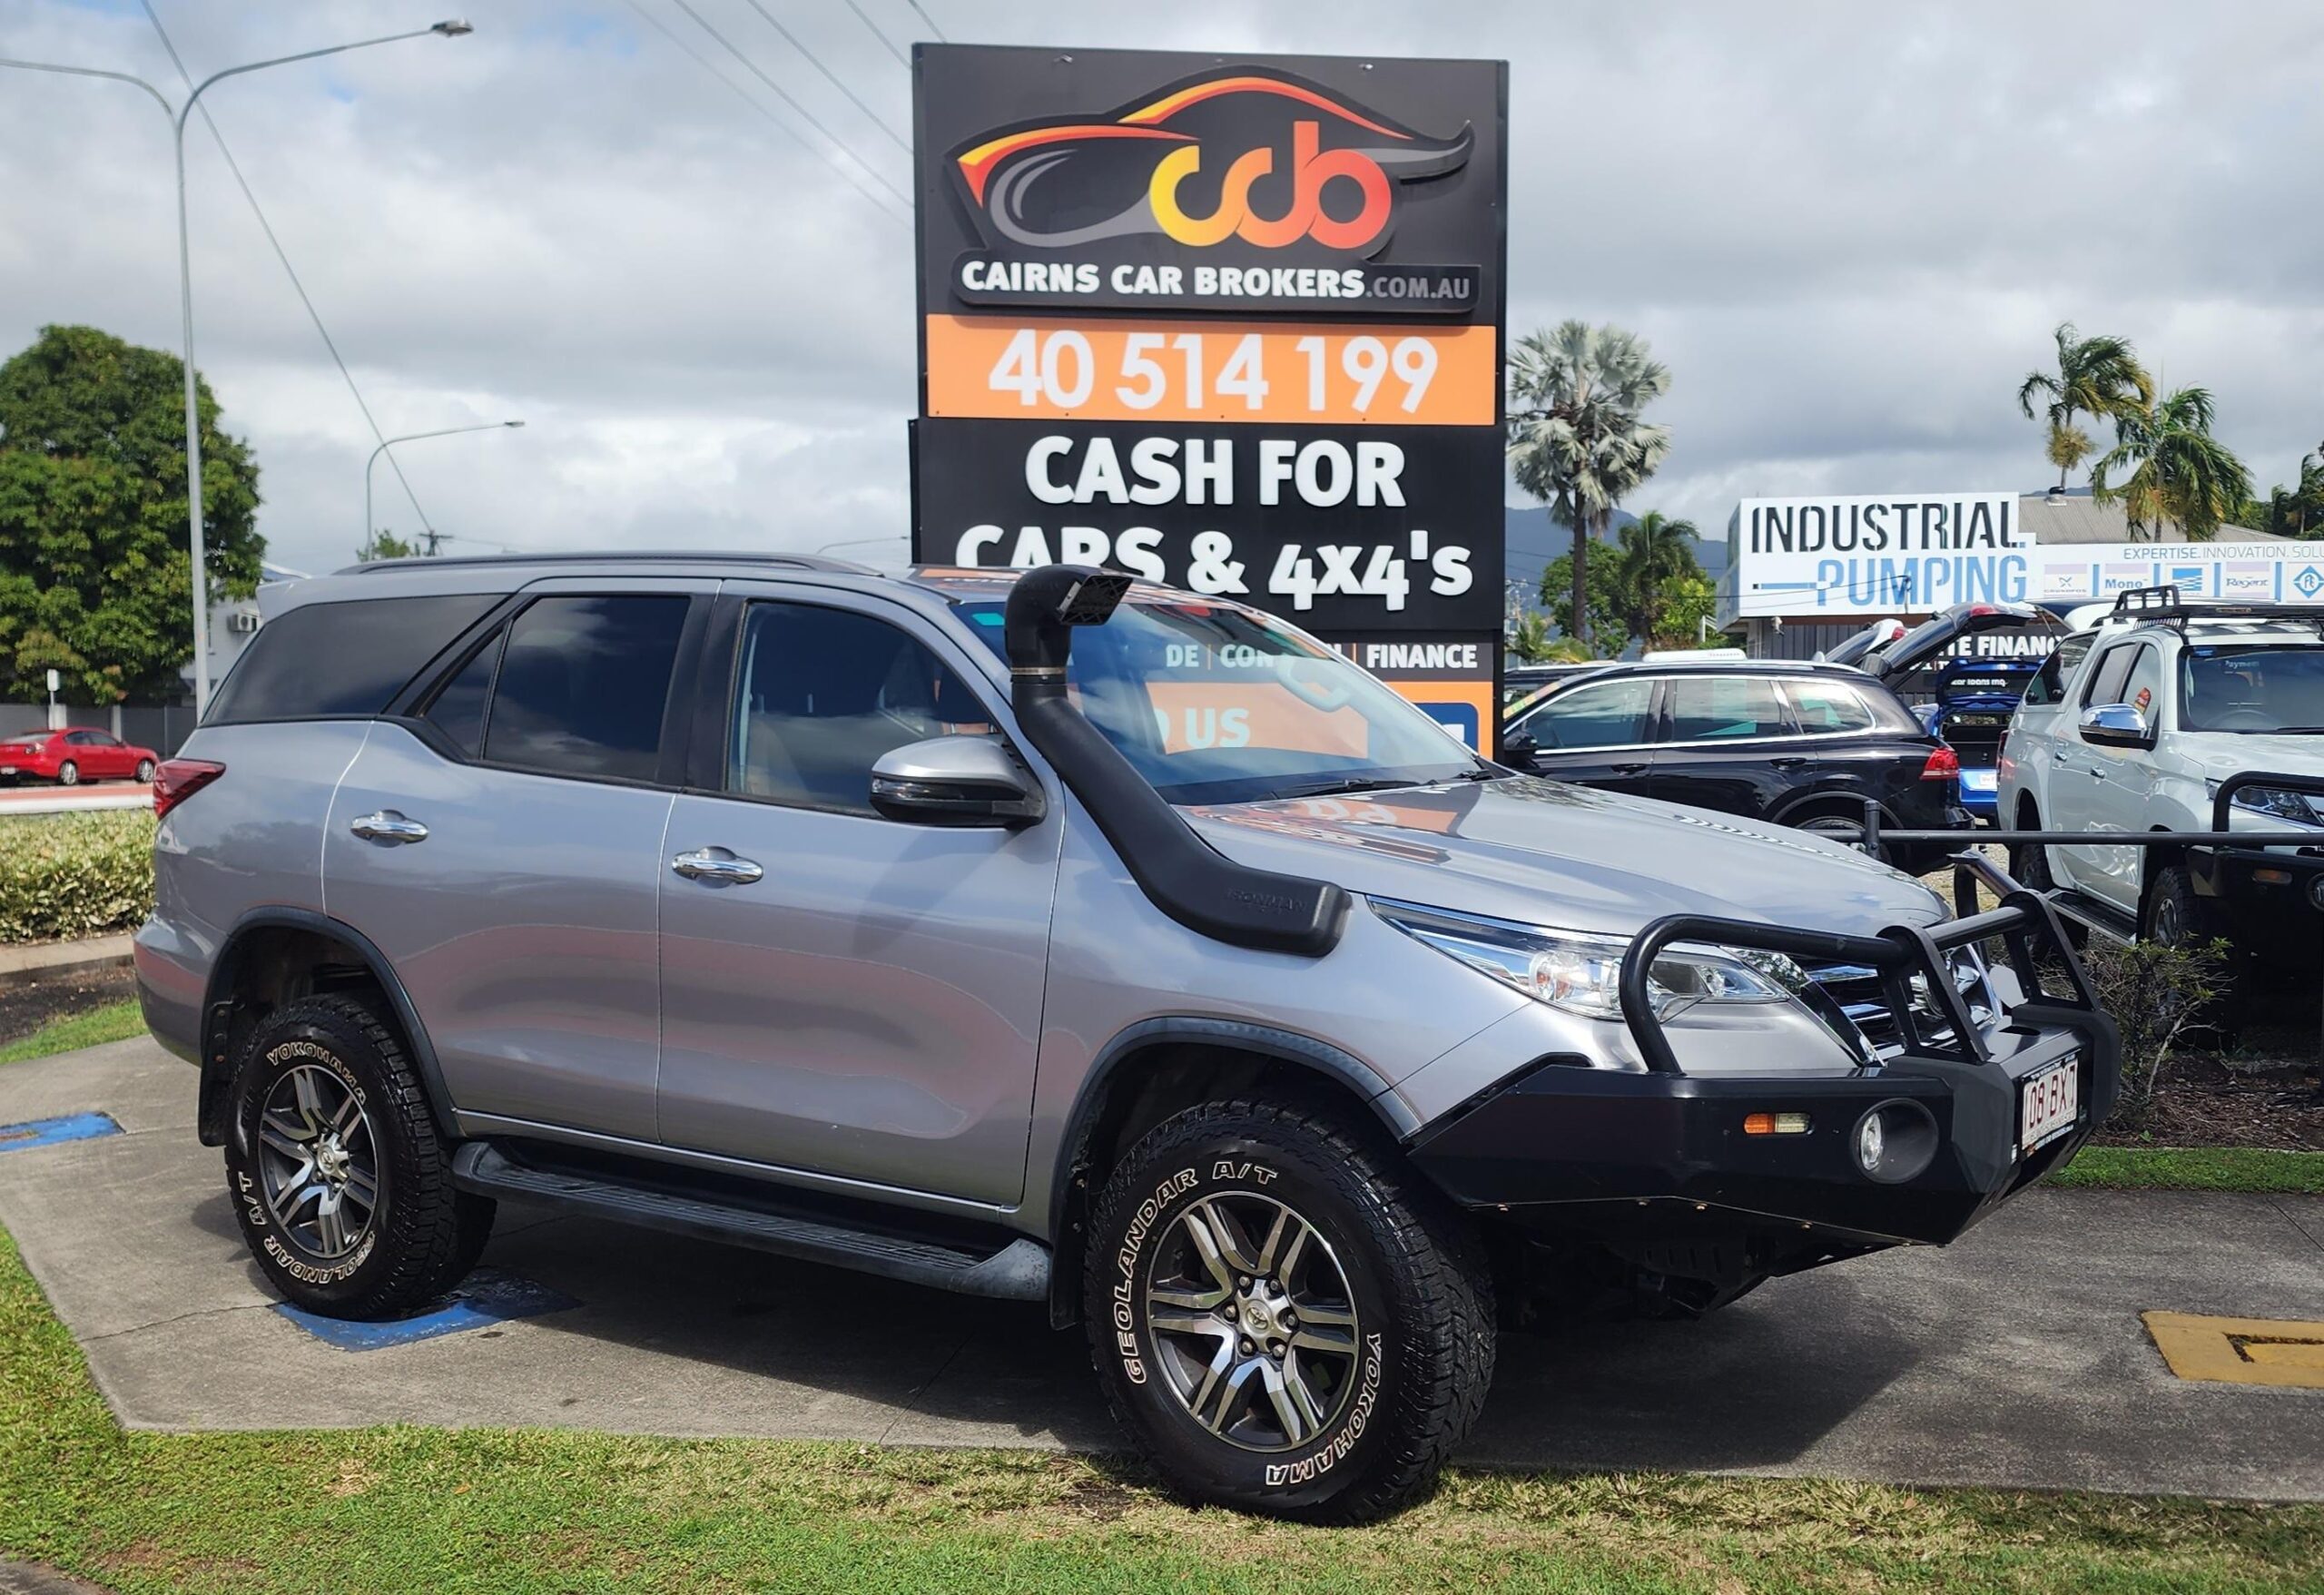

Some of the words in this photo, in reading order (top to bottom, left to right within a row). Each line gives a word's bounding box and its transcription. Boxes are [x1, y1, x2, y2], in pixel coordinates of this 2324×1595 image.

[962, 261, 1099, 294] CAIRNS
[1110, 264, 1184, 296] CAR
[990, 329, 1095, 408] 40
[1116, 332, 1269, 410] 514
[1295, 336, 1438, 413] 199
[1025, 436, 1235, 506] CASH
[1259, 439, 1406, 507] FOR
[1751, 501, 2018, 553] INDUSTRIAL
[2123, 546, 2201, 560] EXPERTISE.
[2203, 545, 2290, 559] INNOVATION.
[955, 525, 1167, 585] CARS
[1187, 531, 1249, 595] &
[1817, 555, 2027, 606] PUMPING
[2104, 578, 2143, 590] Mono
[1366, 644, 1478, 669] FINANCE
[1977, 636, 2062, 656] FINANC
[1184, 707, 1251, 748] US
[266, 1041, 367, 1106] YOKOHAMA
[238, 1170, 268, 1226] A/T
[1113, 1167, 1199, 1384] GEOLANDAR
[1212, 1160, 1278, 1186] A/T
[1265, 1333, 1382, 1486] YOKOHAMA
